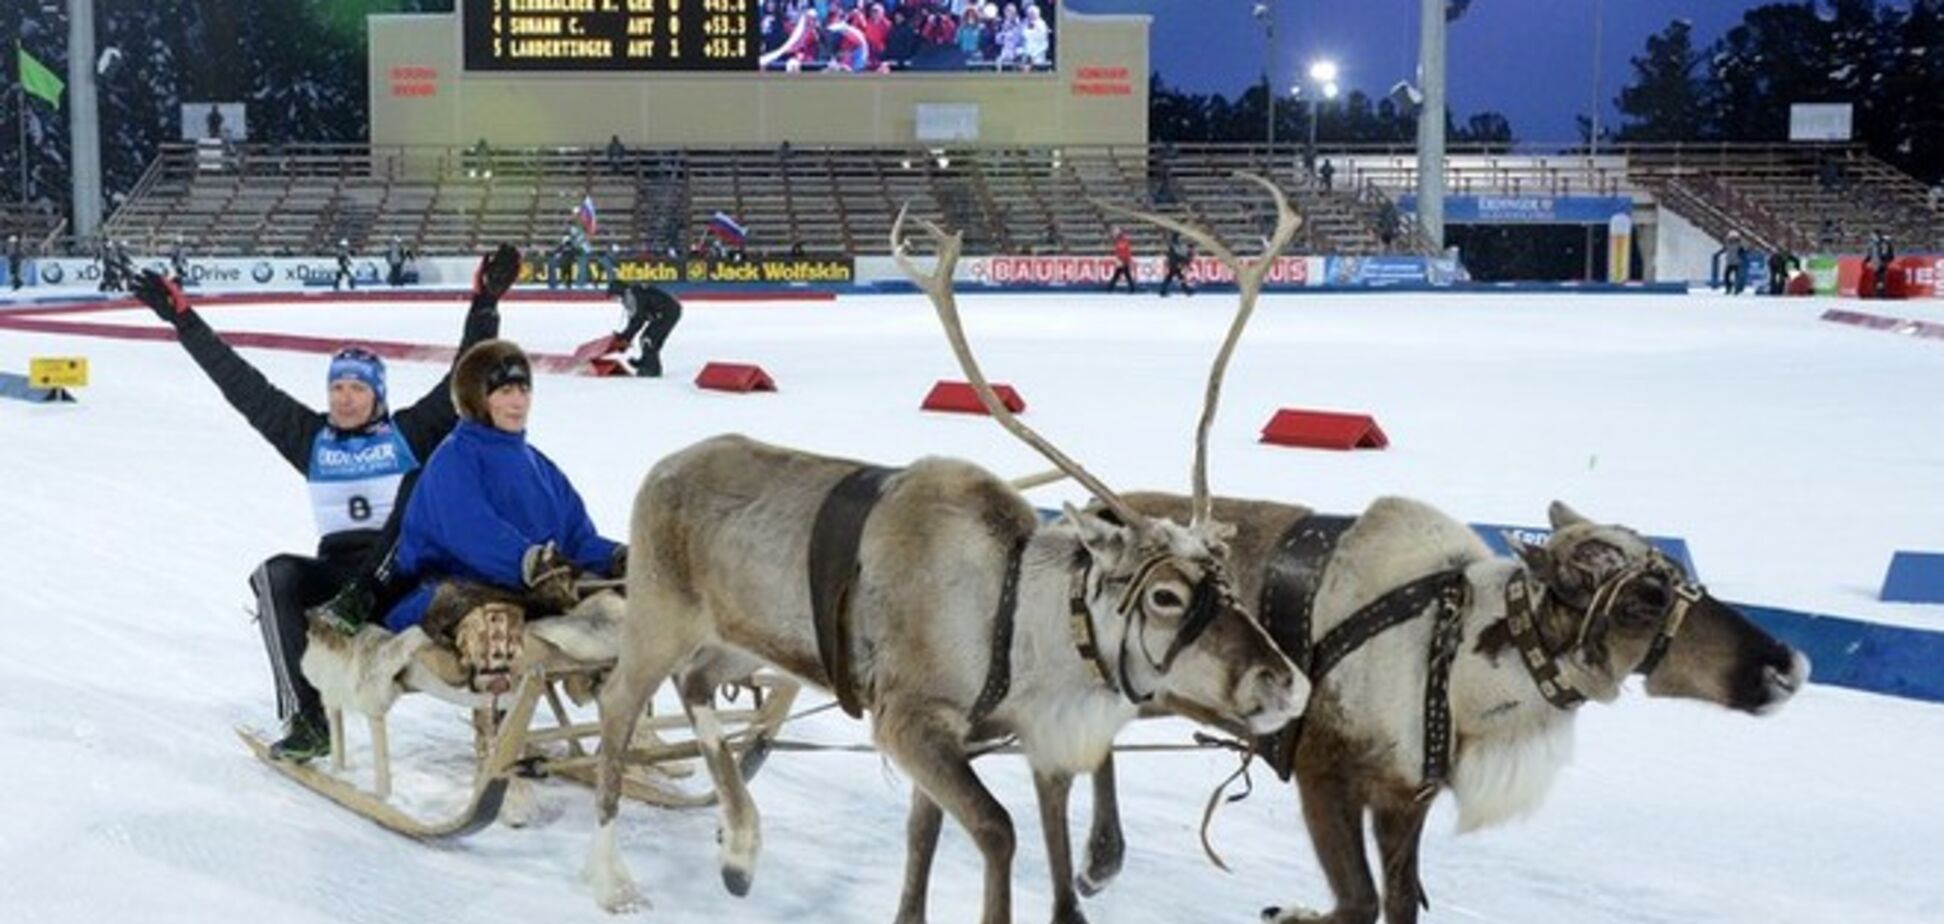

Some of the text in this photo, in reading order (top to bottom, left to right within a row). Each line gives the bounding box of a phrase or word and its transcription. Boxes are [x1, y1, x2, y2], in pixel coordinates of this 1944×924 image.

[492, 16, 502, 35] 4
[567, 16, 584, 35] C.
[627, 16, 654, 35] AUT
[493, 38, 502, 57] 5
[627, 39, 654, 57] AUT
[670, 38, 679, 57] 1
[710, 261, 850, 281] Jack Wolfskin
[993, 259, 1138, 283] BAUHAU
[349, 494, 372, 522] 8
